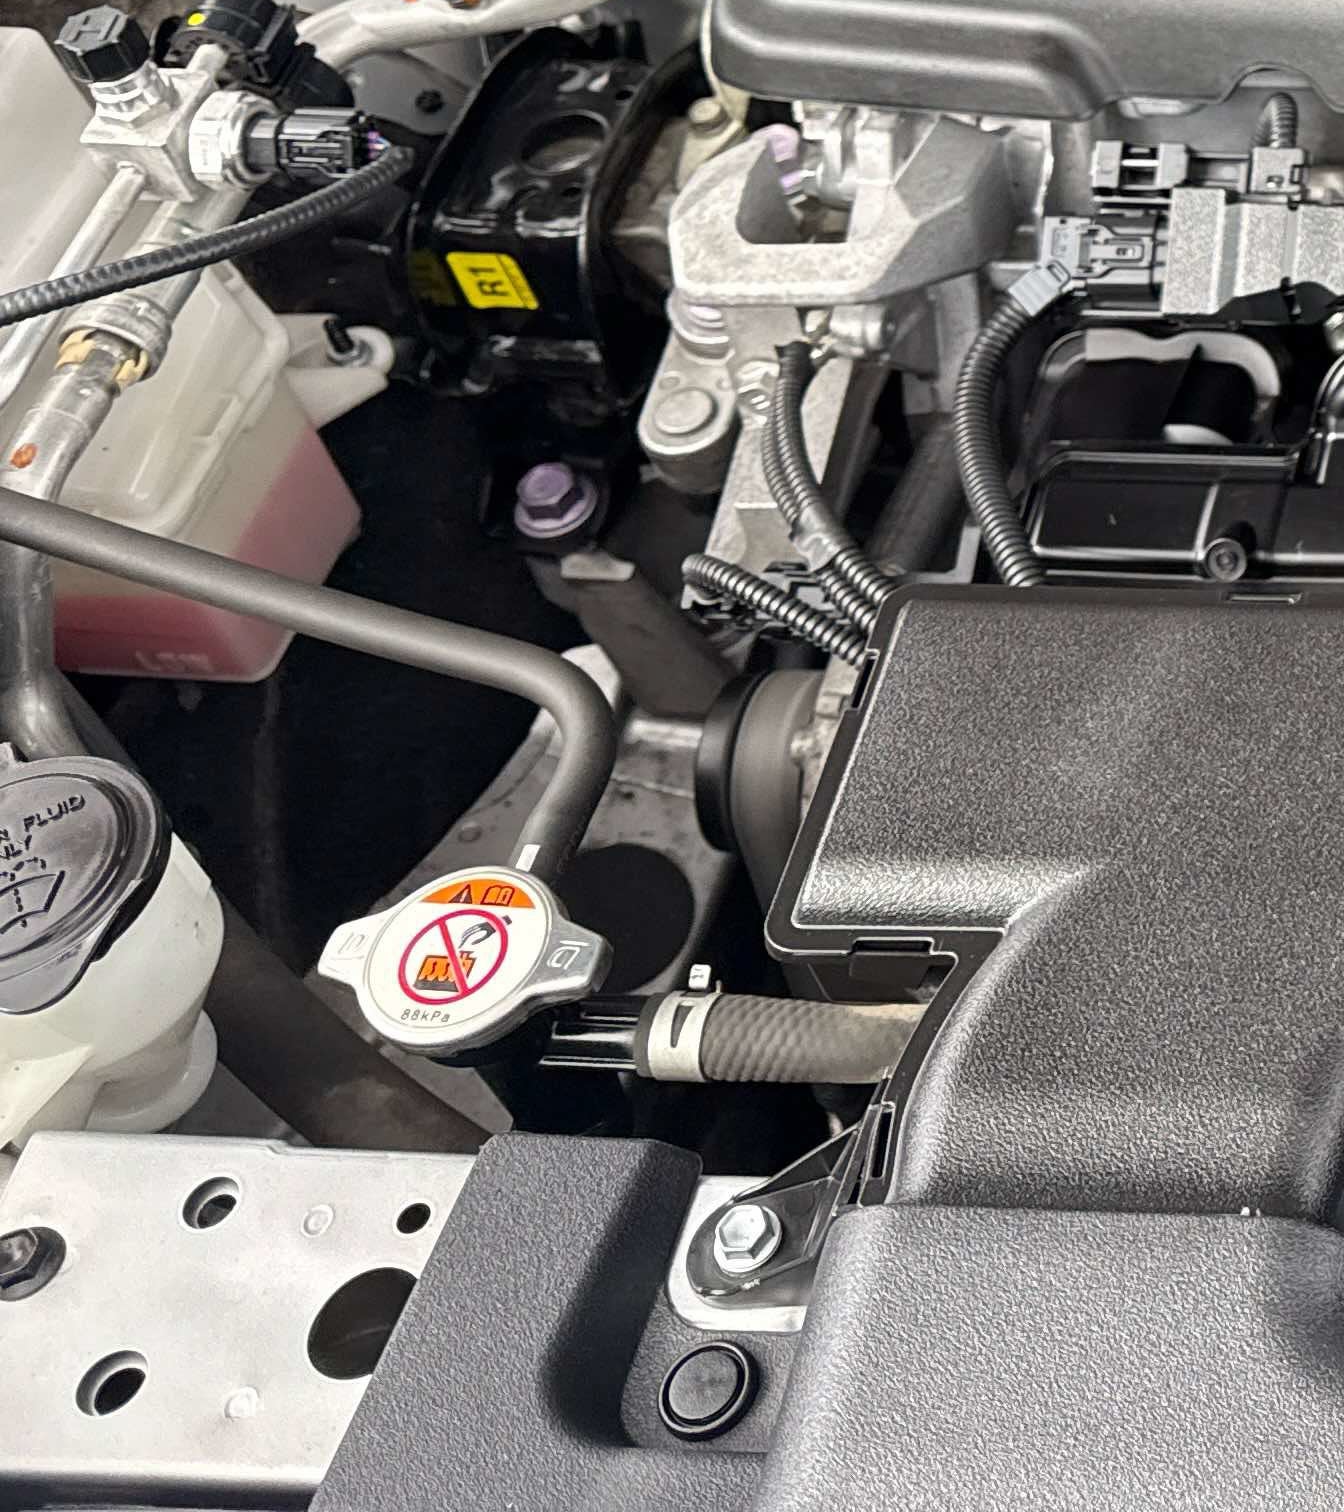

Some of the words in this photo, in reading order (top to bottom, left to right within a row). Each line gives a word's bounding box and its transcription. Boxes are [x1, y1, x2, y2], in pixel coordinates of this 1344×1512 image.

[467, 267, 511, 297] R1
[24, 795, 86, 832] FLUID
[400, 1008, 451, 1024] 88kPa
